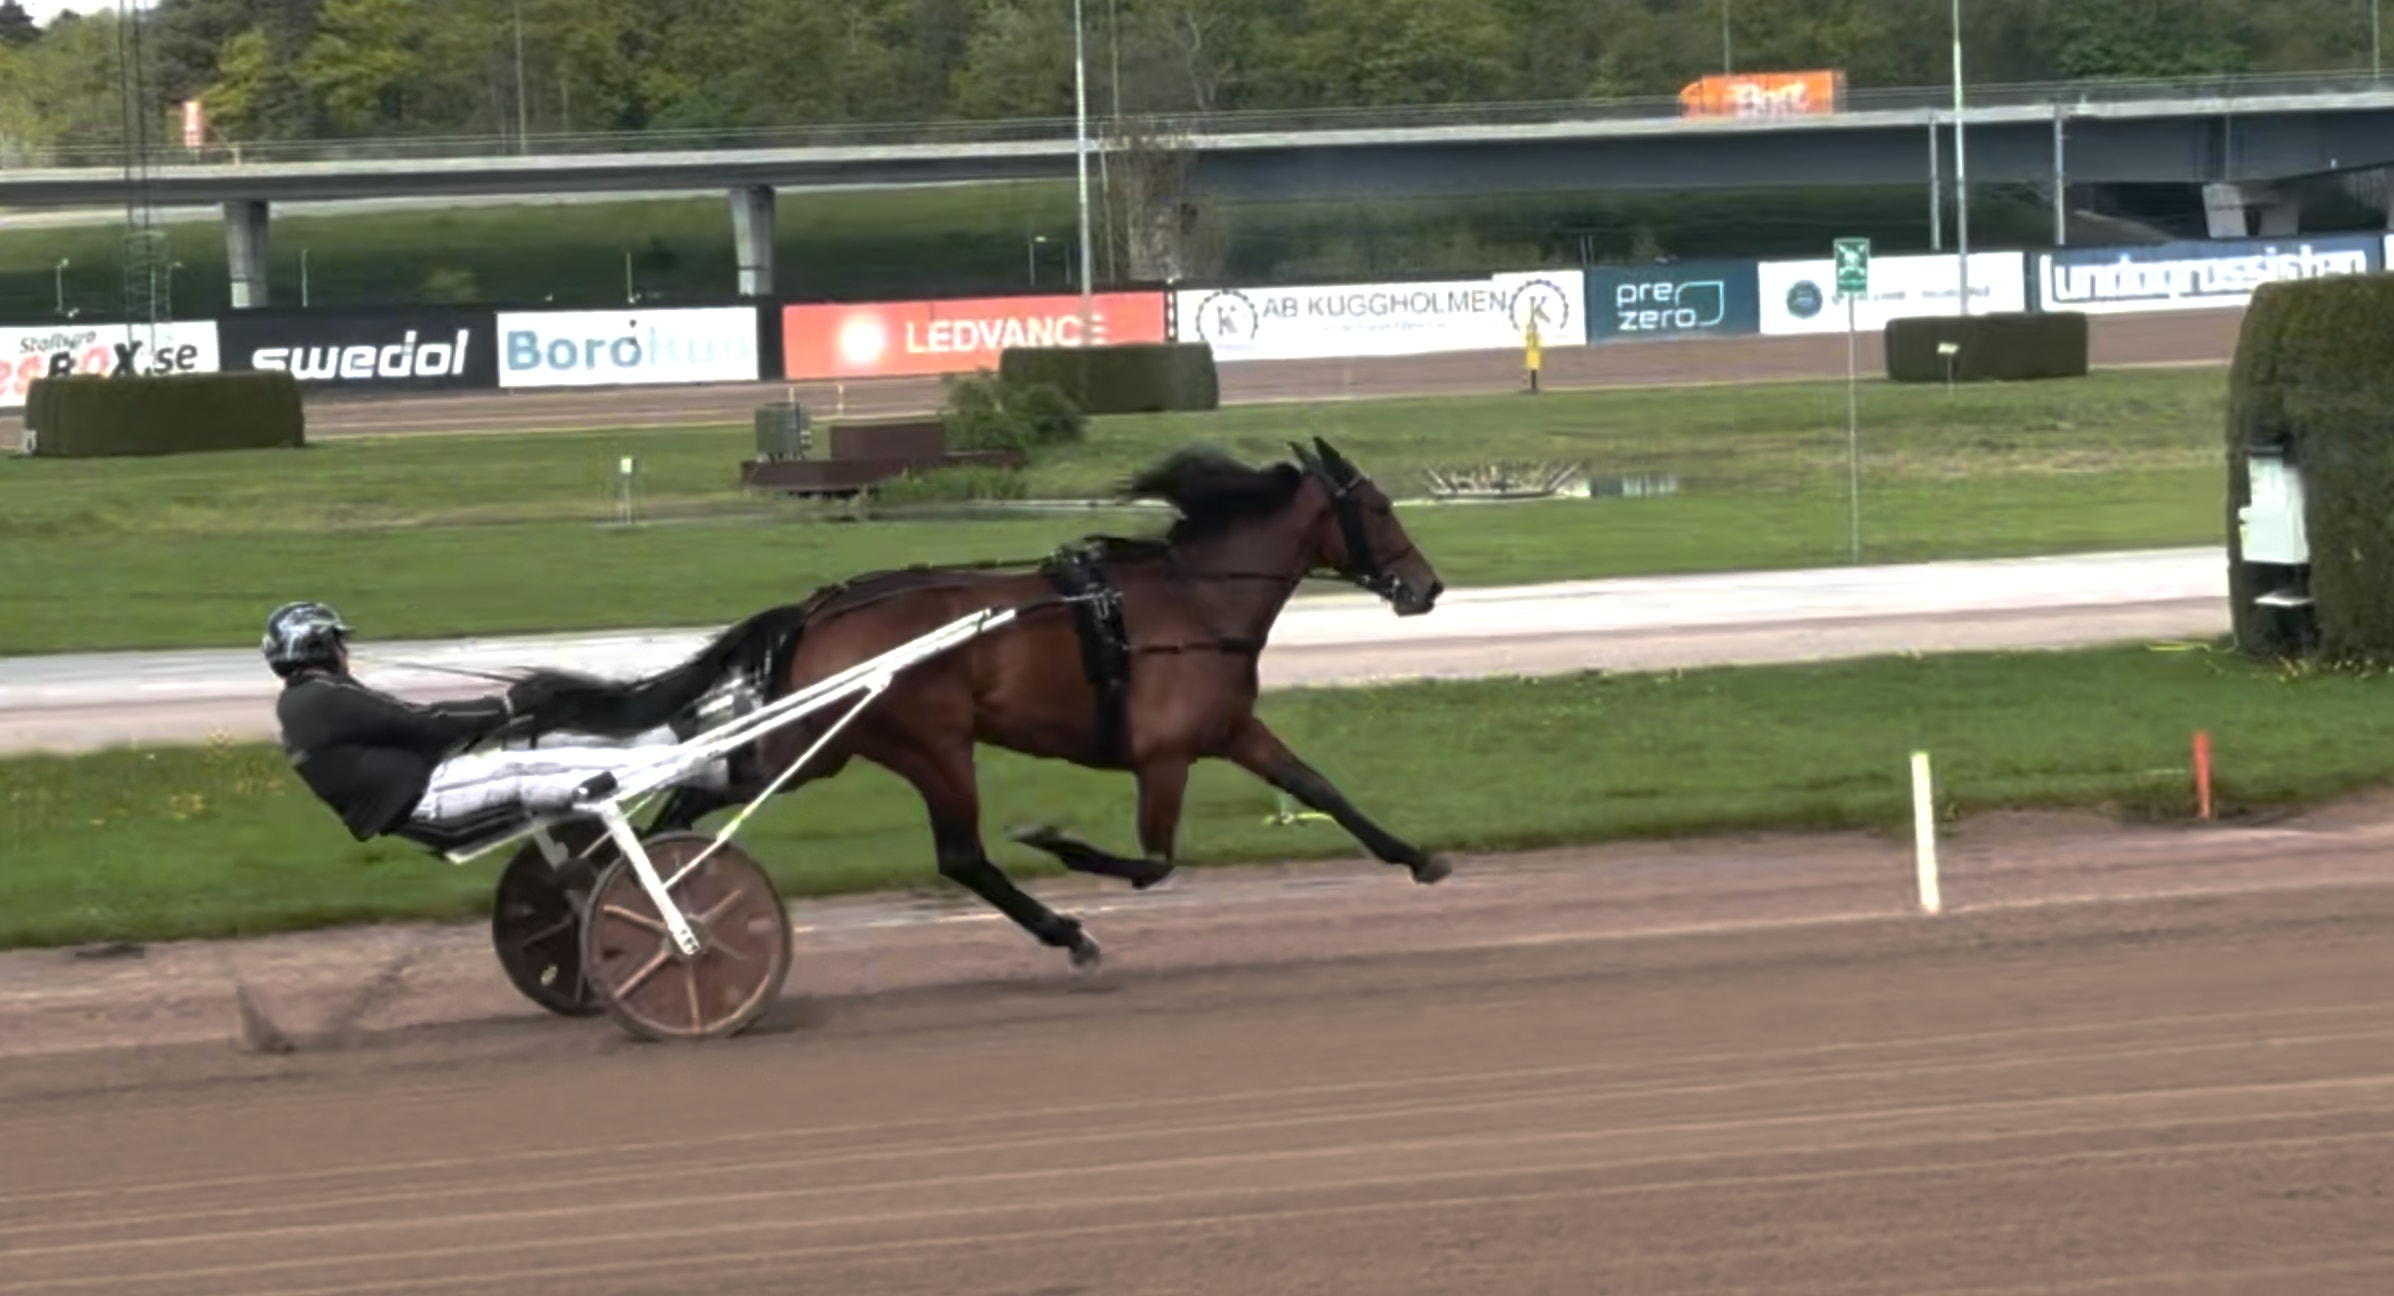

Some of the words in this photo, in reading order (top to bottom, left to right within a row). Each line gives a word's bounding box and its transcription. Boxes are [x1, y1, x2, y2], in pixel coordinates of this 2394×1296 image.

[1262, 297, 1299, 318] AB
[1308, 289, 1507, 318] KUGGHOLMEN
[1616, 281, 1673, 309] pre
[1617, 308, 1697, 331] zero
[252, 329, 470, 380] swedol
